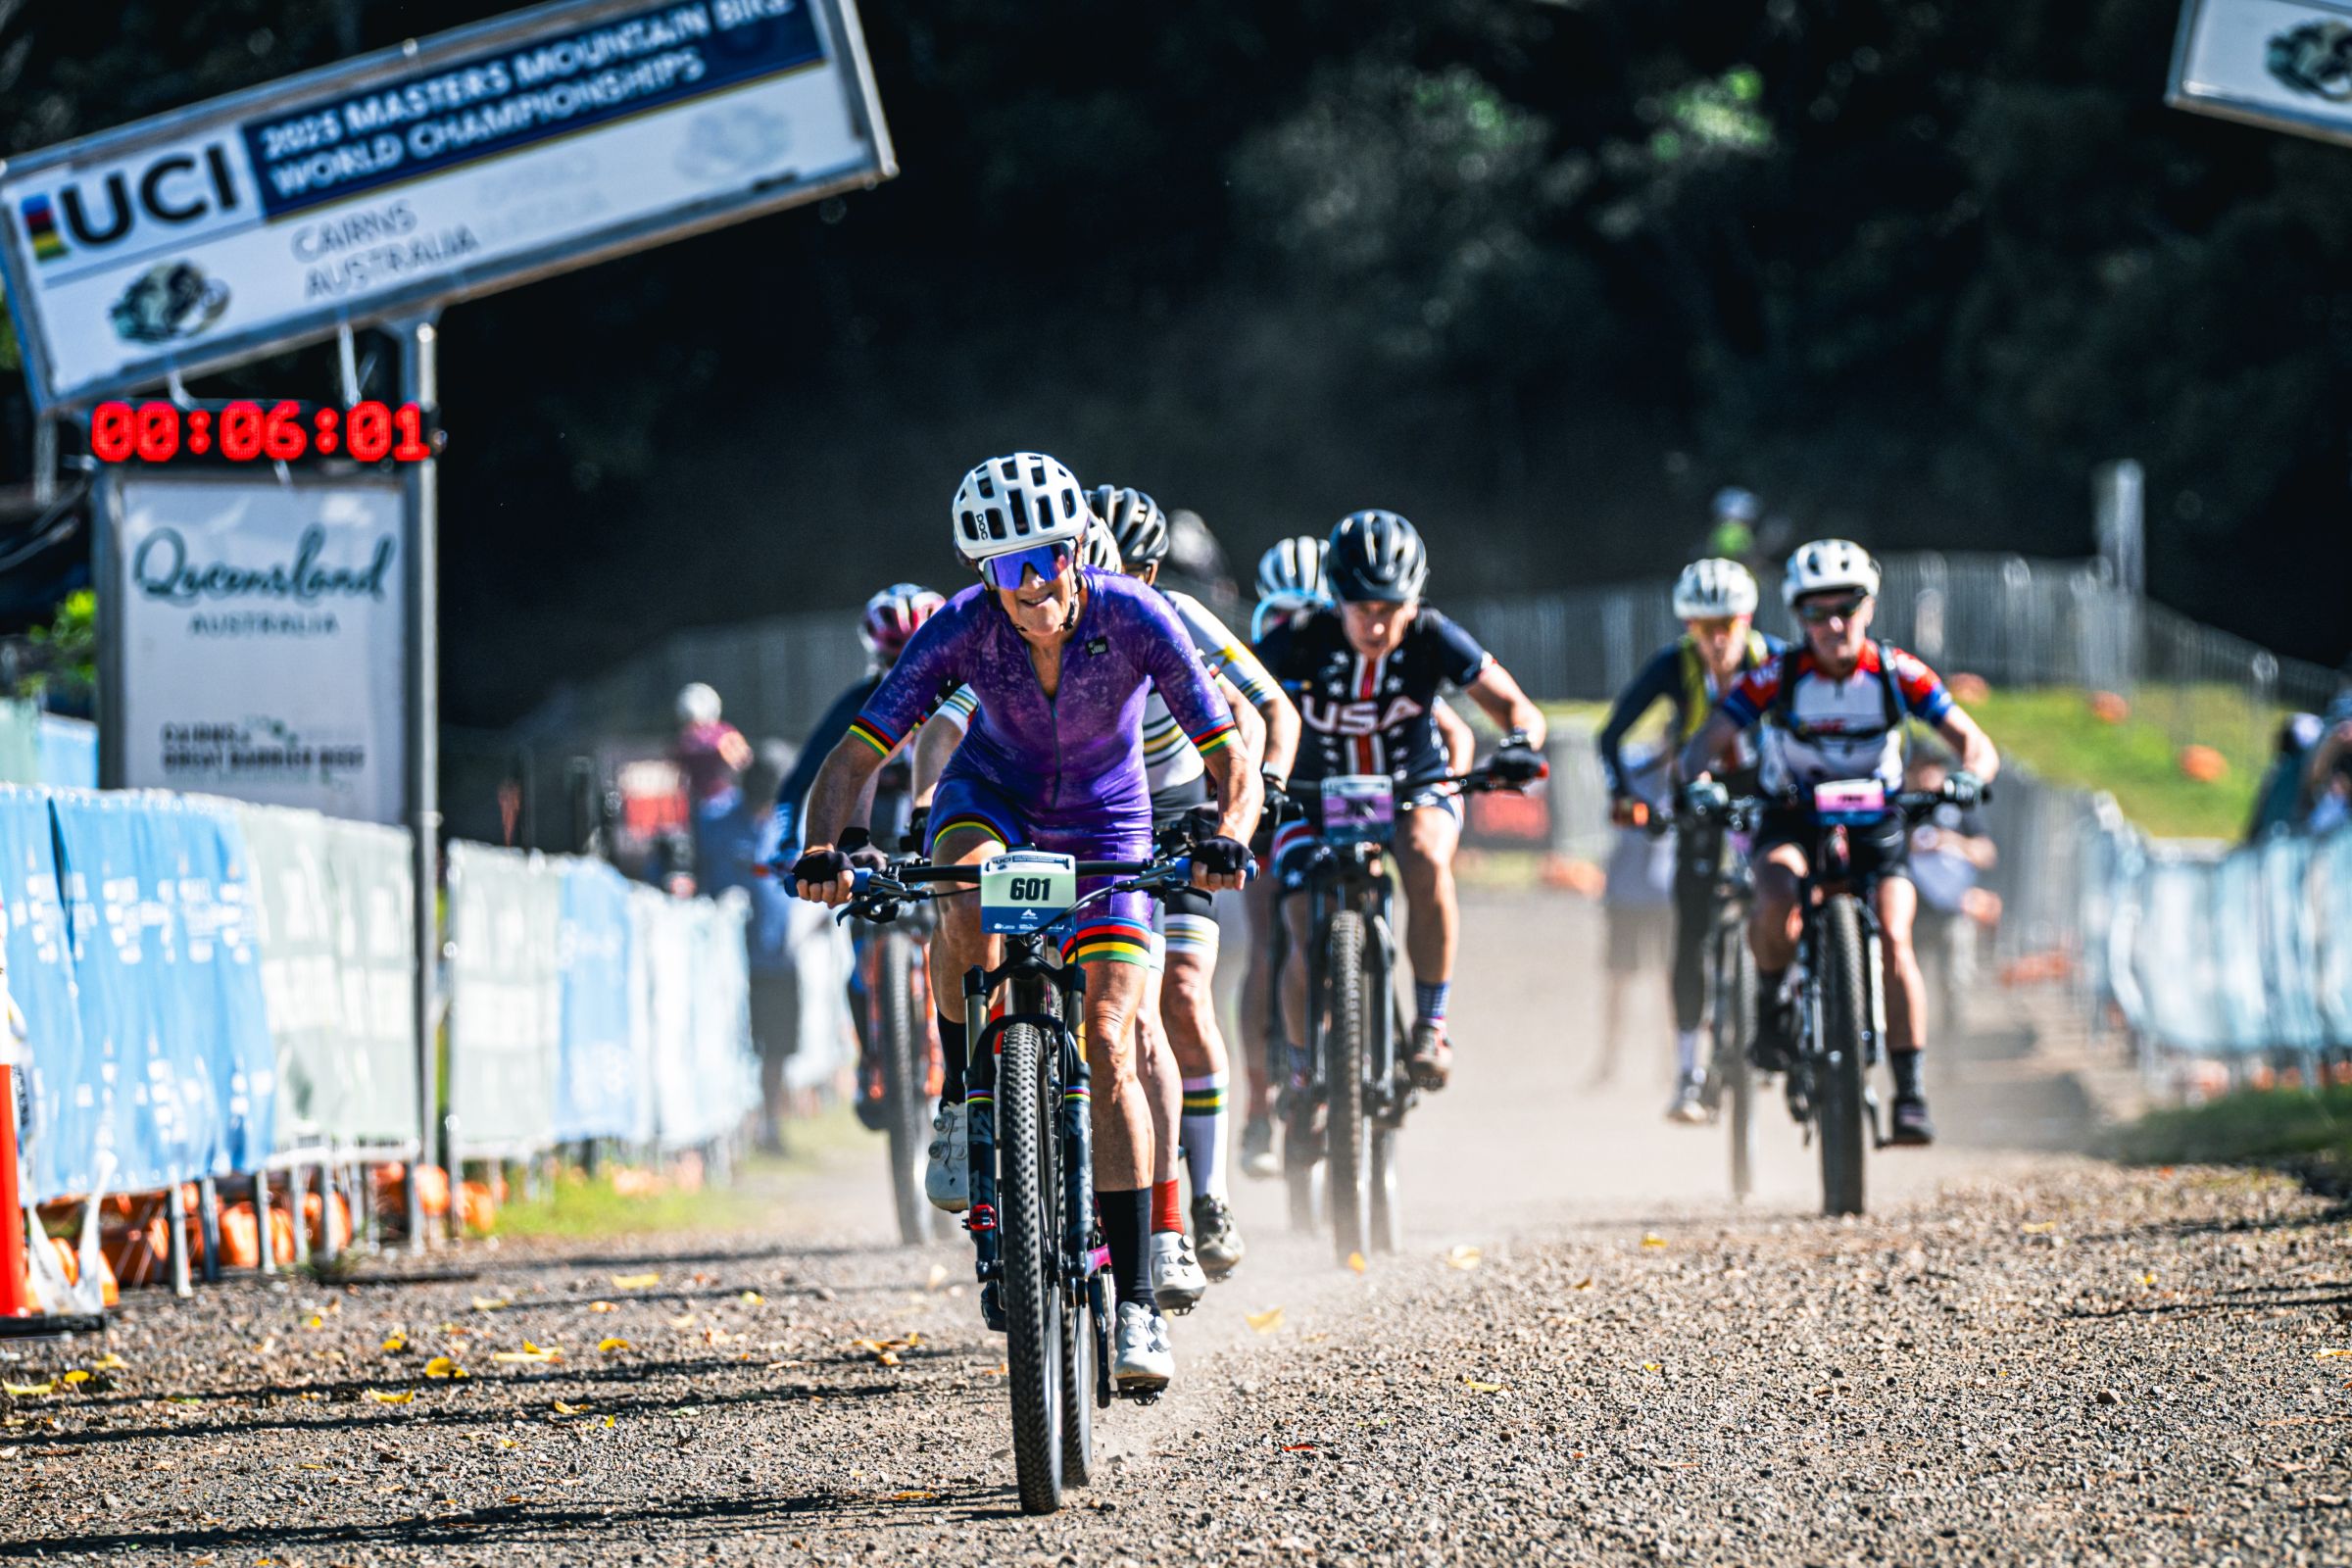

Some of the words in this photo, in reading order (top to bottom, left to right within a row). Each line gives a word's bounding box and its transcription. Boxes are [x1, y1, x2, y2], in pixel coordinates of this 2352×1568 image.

[344, 61, 512, 135] MASTERS
[513, 4, 712, 87] MOUNTAIN
[269, 131, 405, 197] WORLD
[407, 47, 707, 161] CHAMPIONSHIPS
[61, 144, 237, 248] UCI
[291, 199, 416, 265] CAIRNS
[305, 223, 480, 298] AUSTRALIA
[91, 401, 430, 462] 00:06:01
[976, 513, 989, 541] POC
[133, 524, 396, 607] Queensland
[188, 612, 339, 634] AUSTRALIA
[1301, 694, 1424, 734] USA
[1009, 877, 1052, 902] 601
